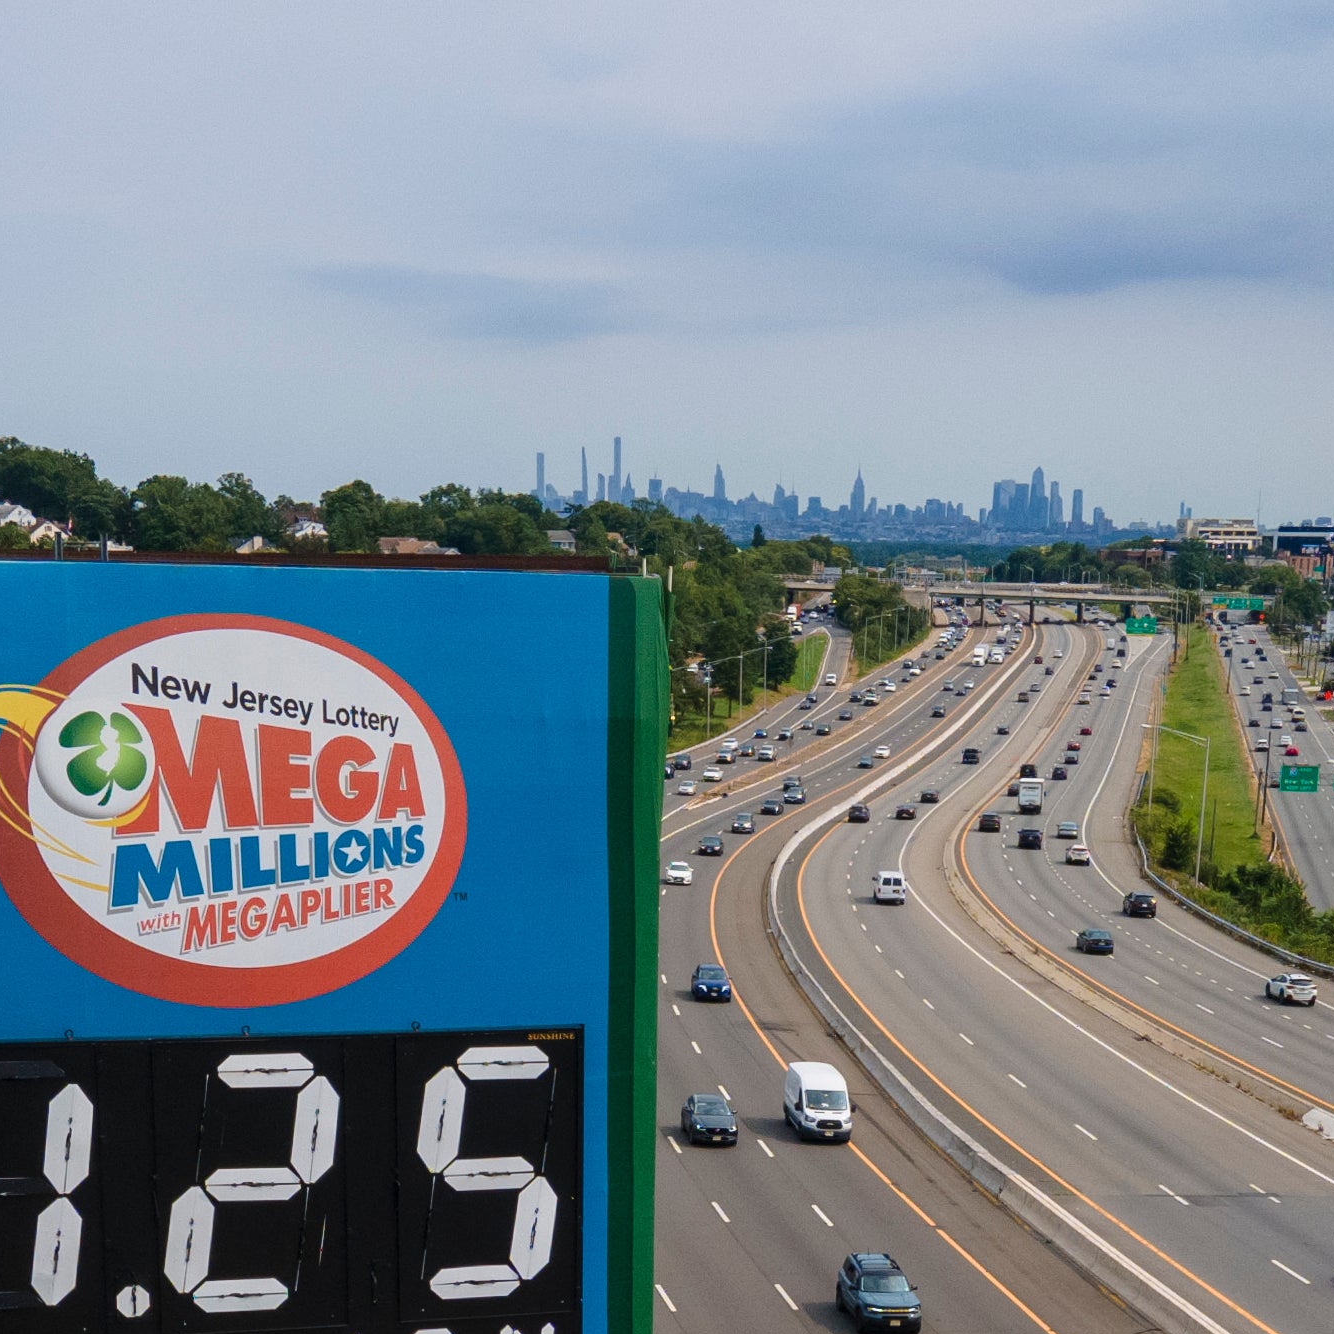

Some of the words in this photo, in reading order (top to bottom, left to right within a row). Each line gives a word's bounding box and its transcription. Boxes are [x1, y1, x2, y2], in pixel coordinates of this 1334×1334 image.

[131, 663, 211, 703] New
[223, 682, 313, 725] Jersey
[322, 699, 400, 738] Lottery
[111, 703, 426, 837] MEGA
[110, 824, 425, 908] MILLIONS
[139, 911, 181, 935] with
[181, 879, 396, 954] MEGAPLIER
[30, 1046, 558, 1318] 1.25
